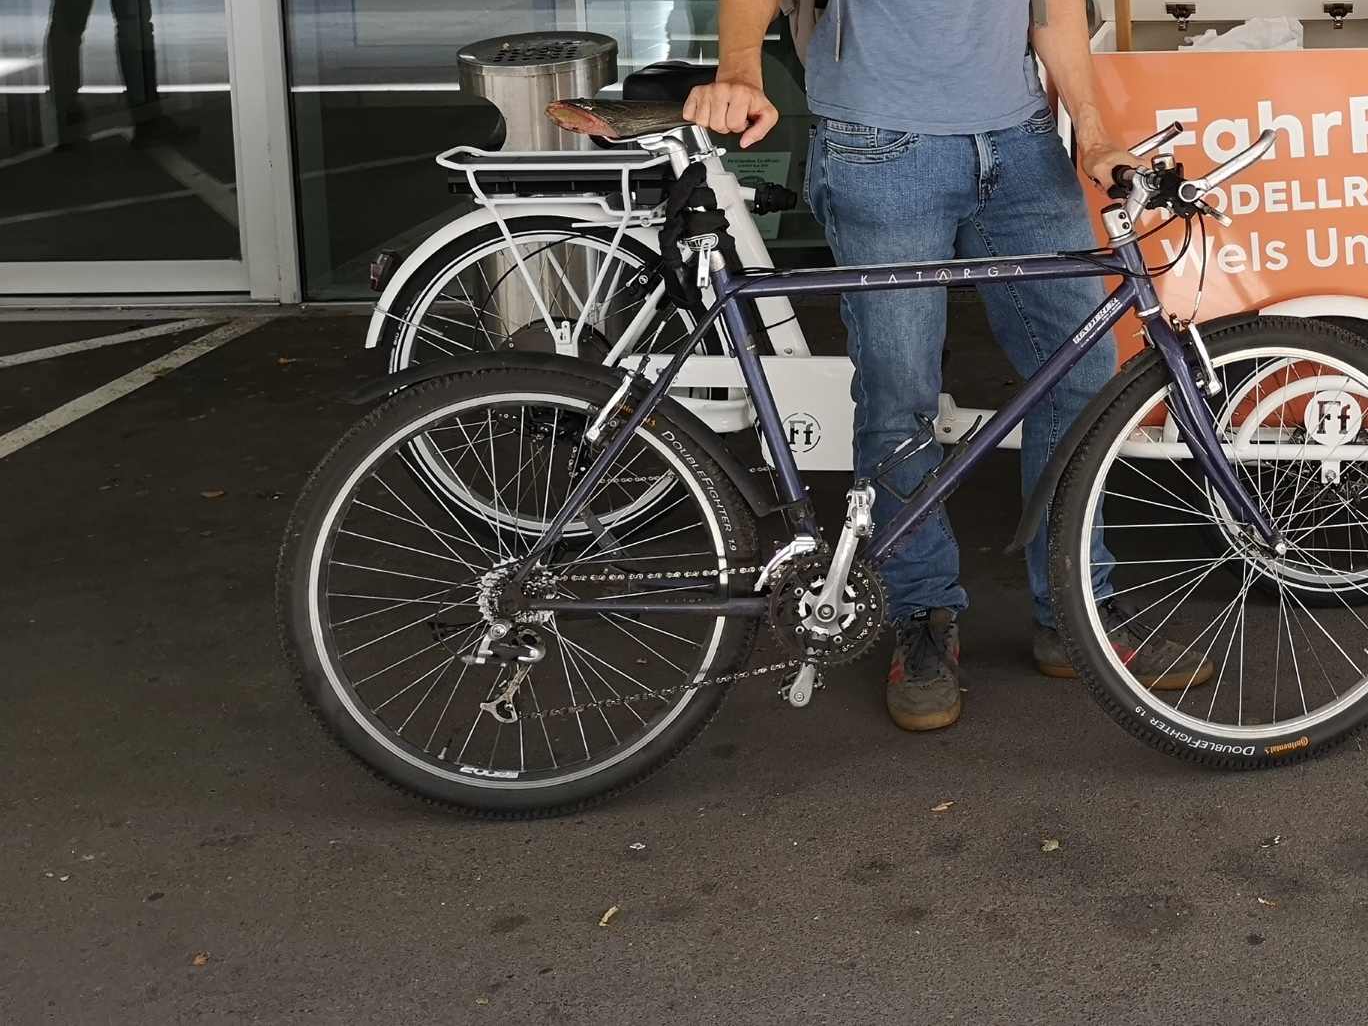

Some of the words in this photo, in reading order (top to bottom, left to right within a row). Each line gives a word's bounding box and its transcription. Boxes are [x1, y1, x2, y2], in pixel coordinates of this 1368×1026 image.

[1161, 231, 1289, 277] Wels
[788, 420, 814, 445] Ff
[727, 538, 737, 552] 1.9
[1134, 705, 1147, 717] 1.9
